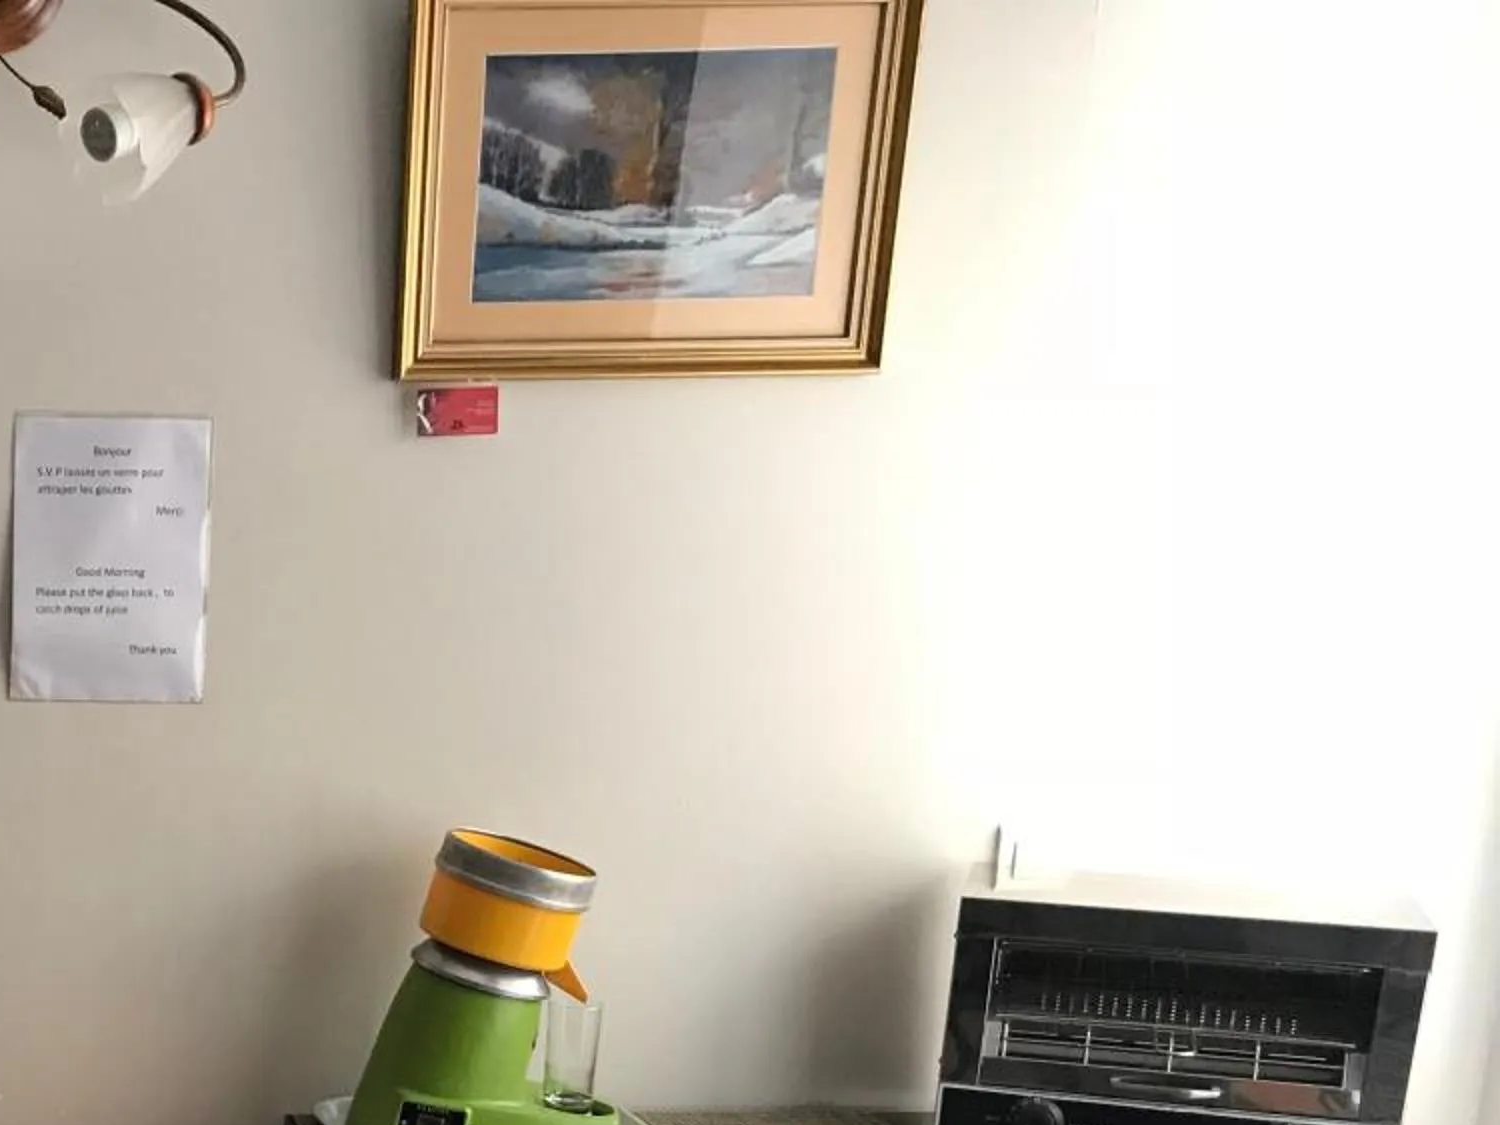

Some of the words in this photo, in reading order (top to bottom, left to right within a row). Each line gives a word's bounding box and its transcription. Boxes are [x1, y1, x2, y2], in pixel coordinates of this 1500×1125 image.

[93, 445, 132, 459] Bonjour
[113, 468, 139, 478] verre
[141, 468, 164, 480] pour
[79, 484, 93, 495] les
[95, 485, 132, 497] gouttes
[155, 505, 184, 517] Merci
[75, 566, 101, 577] Good
[103, 567, 145, 579] Morning
[35, 587, 67, 598] Please
[69, 587, 86, 599] put
[87, 587, 104, 597] the
[163, 587, 174, 597] to
[35, 605, 61, 615] catch
[63, 605, 91, 617] drops
[93, 605, 104, 615] of
[105, 605, 128, 617] juice
[128, 644, 157, 655] Thank
[159, 646, 177, 657] you
